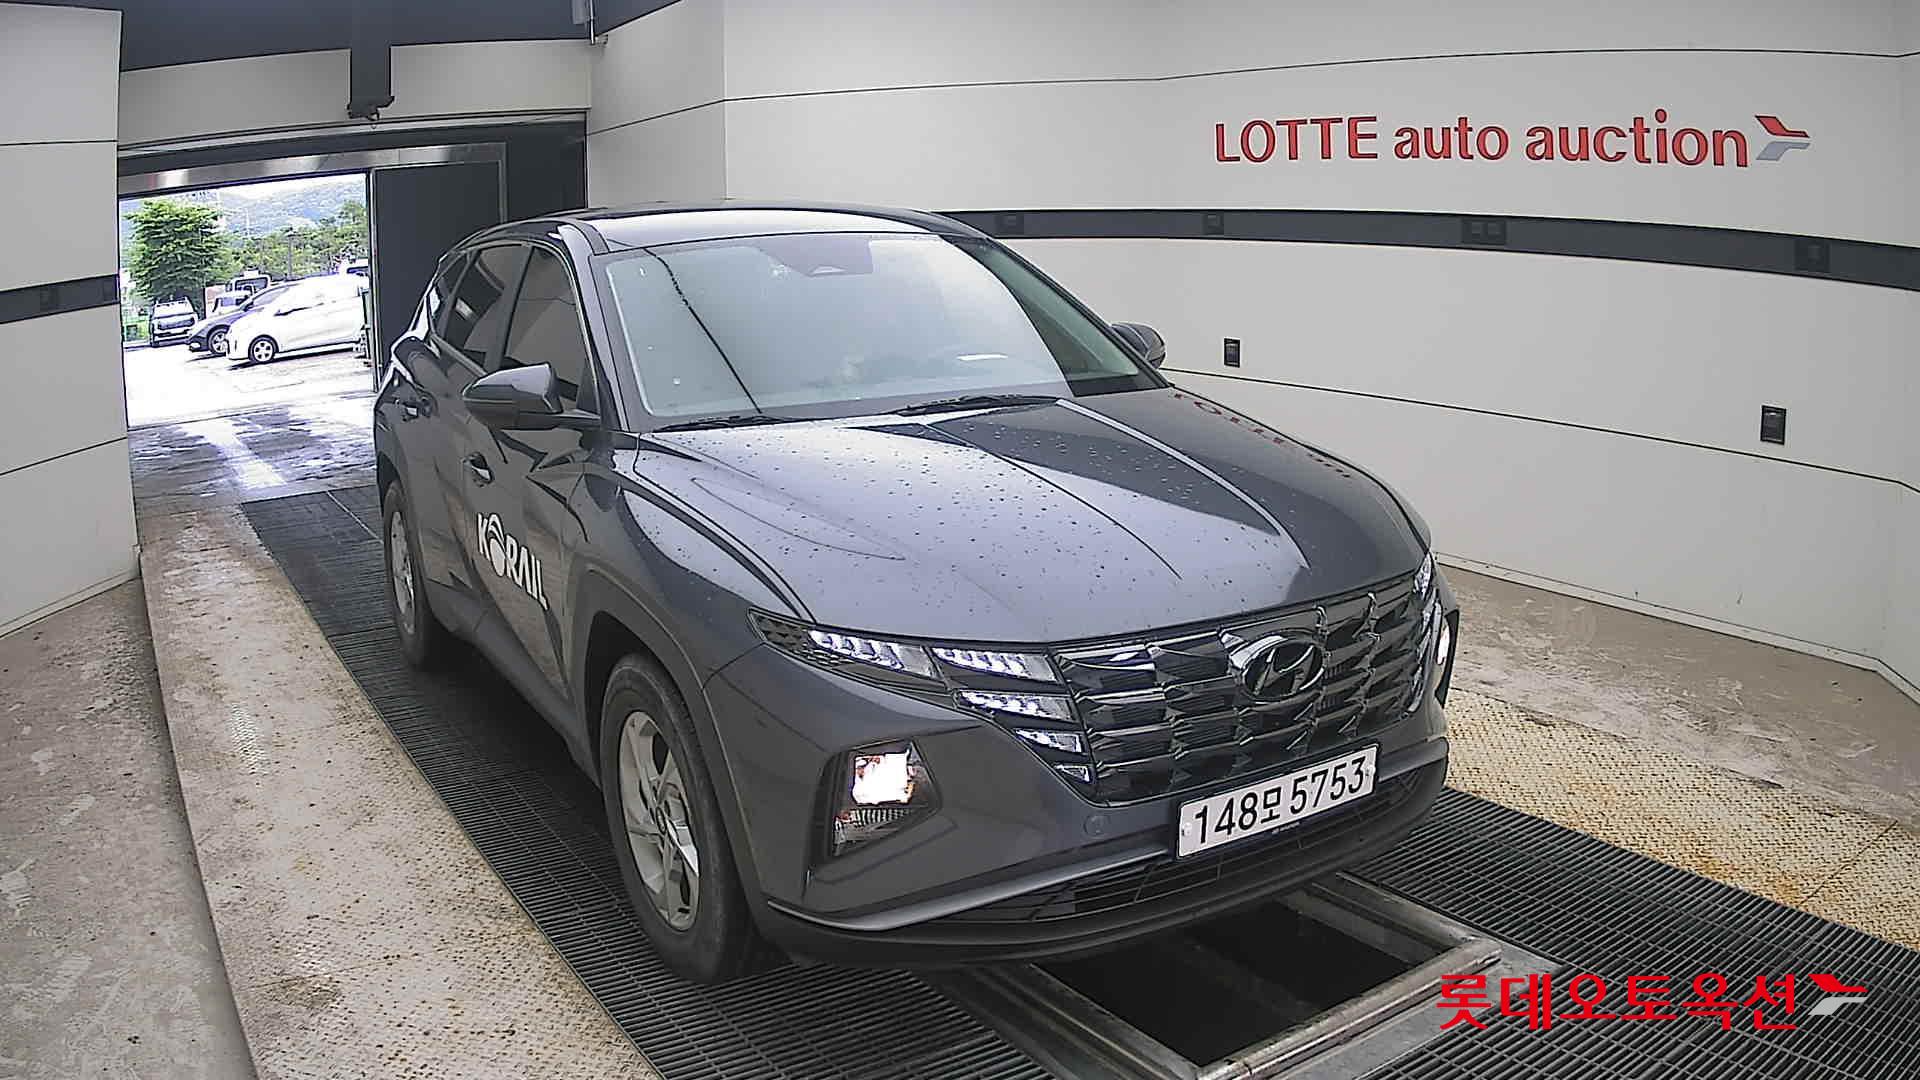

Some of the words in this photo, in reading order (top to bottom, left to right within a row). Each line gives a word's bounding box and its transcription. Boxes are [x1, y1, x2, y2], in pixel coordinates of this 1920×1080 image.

[1215, 115, 1378, 163] LOTTE
[1394, 116, 1510, 160] auto
[1525, 109, 1749, 168] auction
[476, 512, 549, 611] KORAIL
